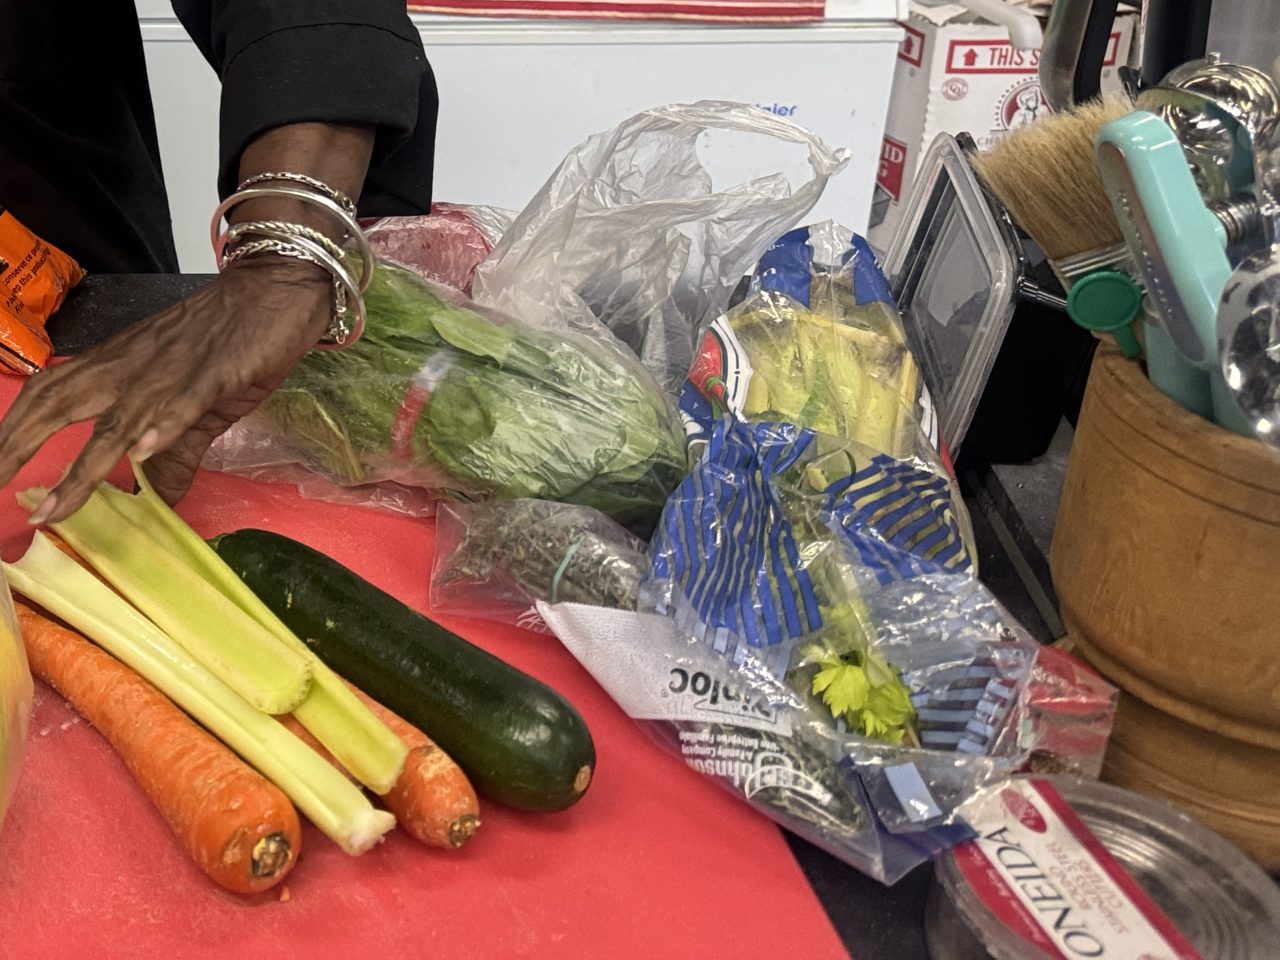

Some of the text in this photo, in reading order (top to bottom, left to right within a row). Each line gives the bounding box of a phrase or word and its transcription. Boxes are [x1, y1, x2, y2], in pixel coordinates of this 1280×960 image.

[988, 47, 1024, 66] THIS
[18, 271, 33, 287] this
[717, 746, 746, 759] Family
[982, 825, 1104, 955] ONEIDA
